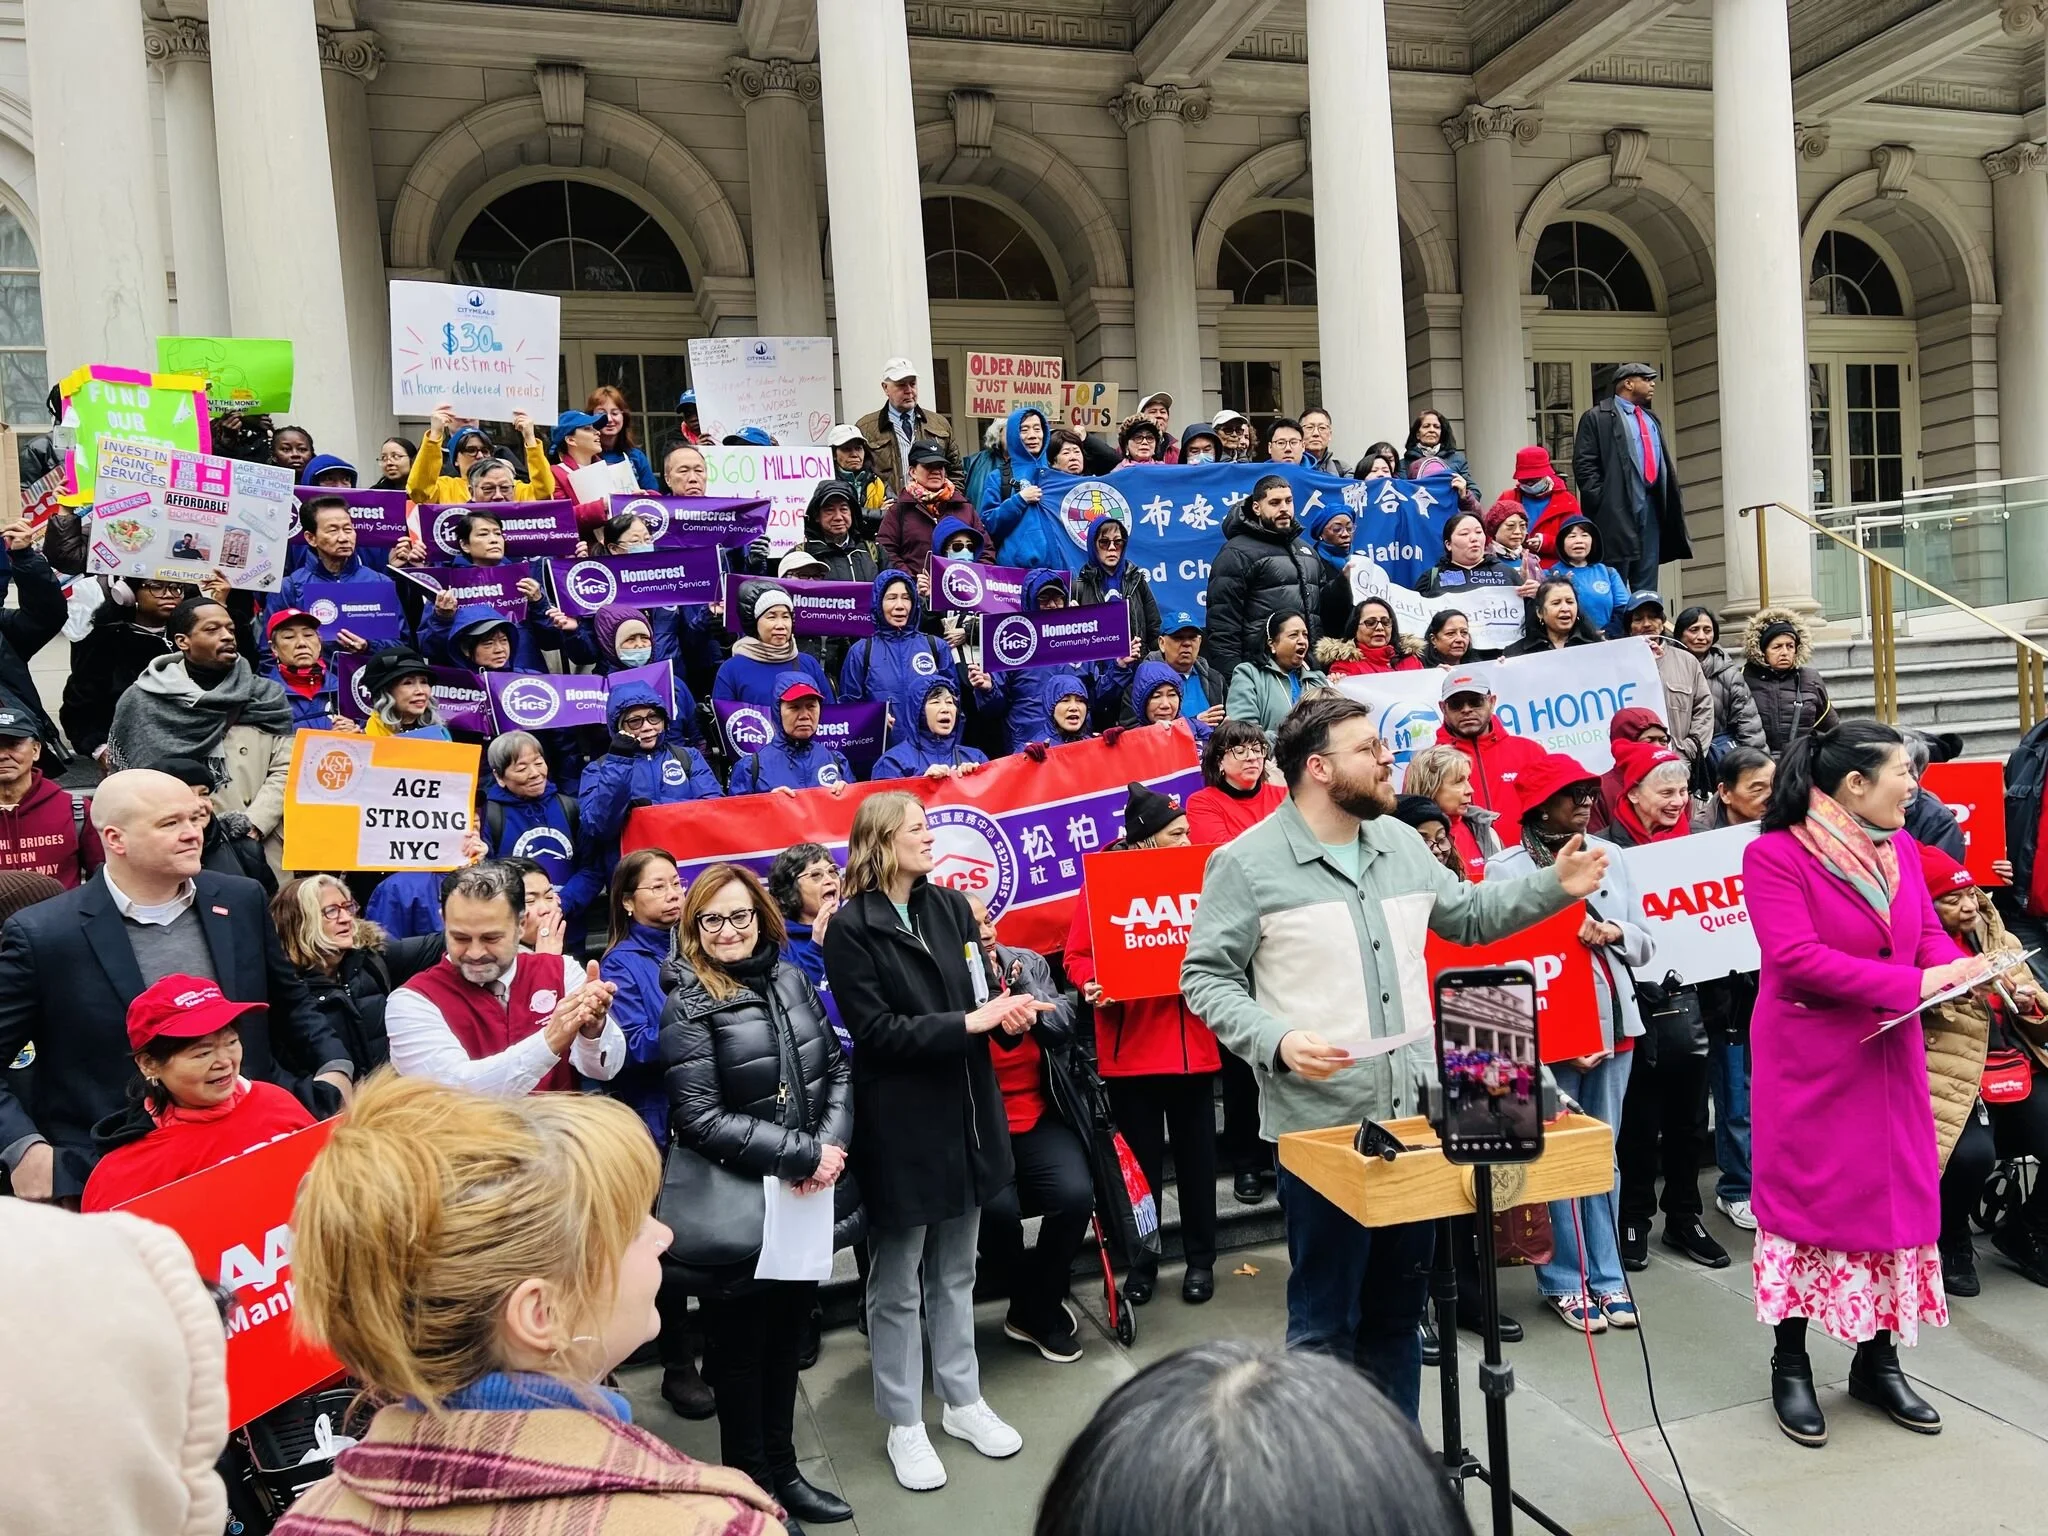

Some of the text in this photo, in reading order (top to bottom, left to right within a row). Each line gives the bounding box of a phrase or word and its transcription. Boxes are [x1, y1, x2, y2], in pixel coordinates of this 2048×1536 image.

[457, 306, 495, 316] CITYMEALS
[431, 355, 516, 374] investment
[970, 354, 1061, 380] OLDER ADULTS
[976, 378, 1052, 395] JUST WANNA
[1061, 383, 1106, 406] TOP
[88, 382, 150, 410] FUND
[972, 397, 1006, 414] HAVE
[107, 411, 147, 433] OUR
[1071, 406, 1111, 427] CUTS
[103, 440, 150, 458] INVEST
[154, 451, 168, 462] IN
[111, 454, 155, 472] AGING
[237, 463, 256, 473] AGE
[763, 455, 831, 480] MILLION
[102, 465, 166, 487] SERVICES
[236, 474, 292, 492] AGE AT HOME
[242, 486, 258, 496] AGE
[100, 495, 148, 515] WELLNESS
[165, 493, 227, 513] AFFORDABLE
[350, 506, 385, 520] crest
[674, 508, 737, 522] Homecrest
[353, 522, 373, 533] unity
[501, 516, 557, 531] omecrest
[682, 522, 758, 534] Community Services
[233, 559, 272, 585] HOUSING
[620, 565, 686, 584] Homecrest
[630, 579, 711, 594] Community Services
[986, 579, 1022, 594] Homecr
[341, 603, 381, 613] Homecrest
[793, 594, 856, 610] Homecrest
[800, 611, 871, 622] Community Servic
[1041, 619, 1099, 638] Homecrest
[1002, 638, 1028, 650] HCS
[1050, 633, 1120, 649] Community Services
[514, 700, 548, 711] HCS
[816, 721, 850, 736] crest
[841, 736, 874, 748] Services
[1549, 728, 1602, 751] SENIOR
[392, 777, 441, 799] AGE
[365, 807, 466, 831] STRONG
[20, 834, 64, 849] BRIDGES
[389, 841, 440, 861] NYC
[994, 840, 1012, 898] SERVICES
[1642, 873, 1745, 922] AARP
[1109, 893, 1201, 932] AAR
[1700, 911, 1748, 933] Quee
[219, 1223, 293, 1292] AA
